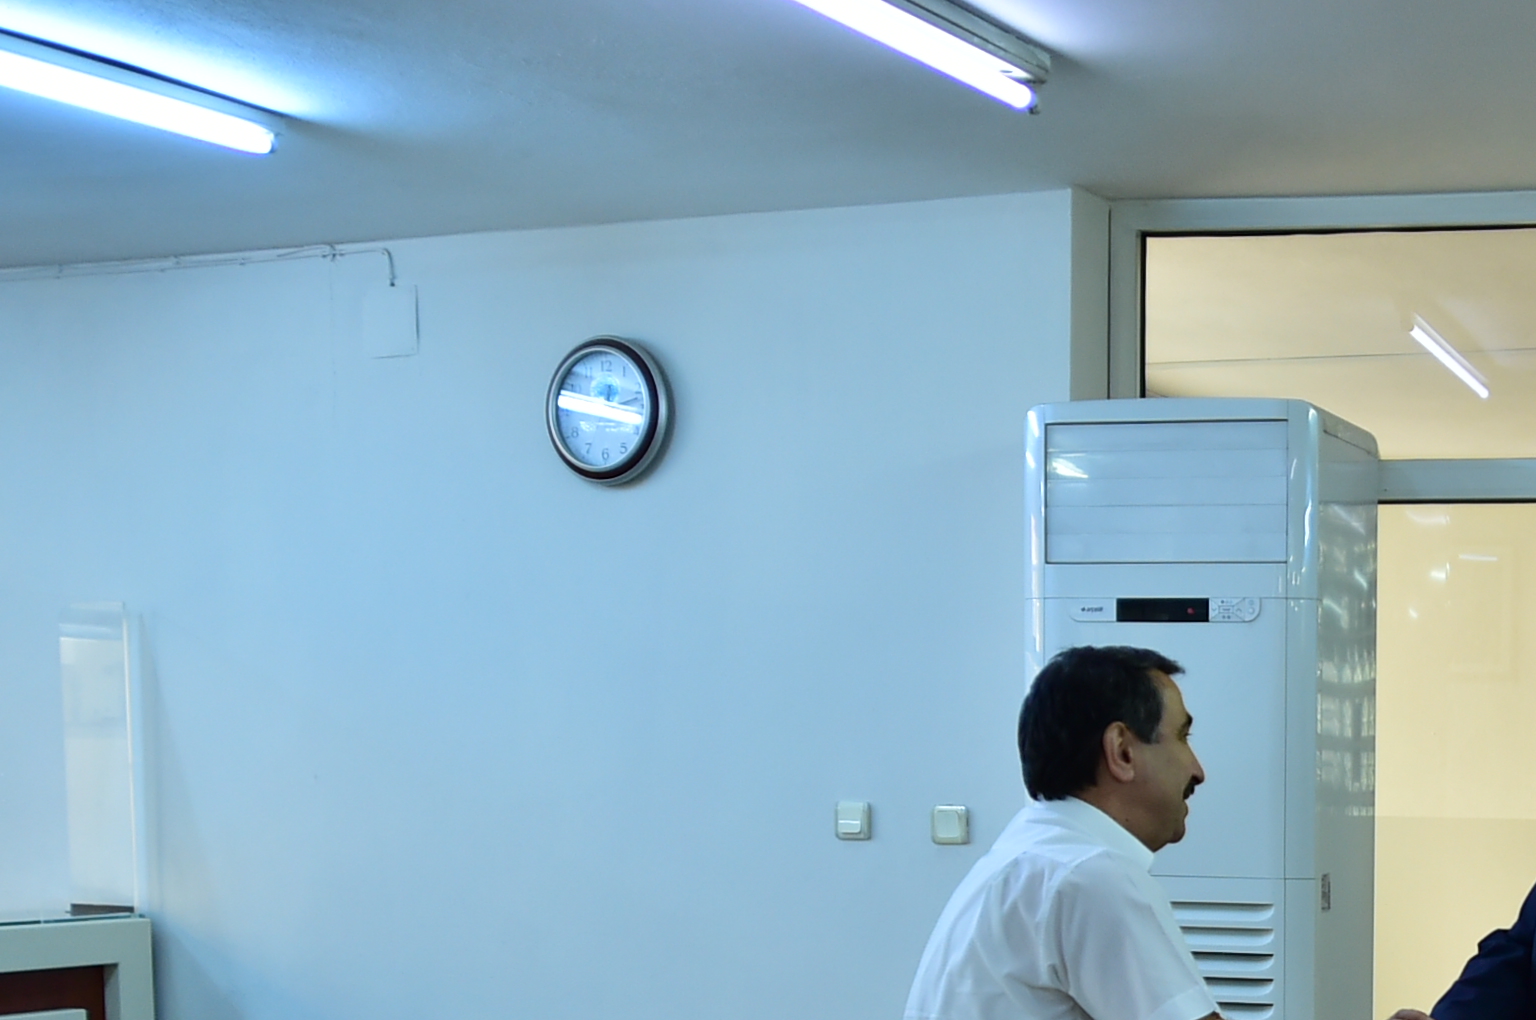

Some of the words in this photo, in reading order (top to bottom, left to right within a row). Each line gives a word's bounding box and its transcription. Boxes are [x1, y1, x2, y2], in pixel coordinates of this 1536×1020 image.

[601, 360, 612, 372] 12
[622, 365, 626, 377] 1
[571, 426, 579, 438] 8
[585, 442, 592, 454] 7
[601, 447, 610, 461] 6
[619, 442, 628, 455] 5
